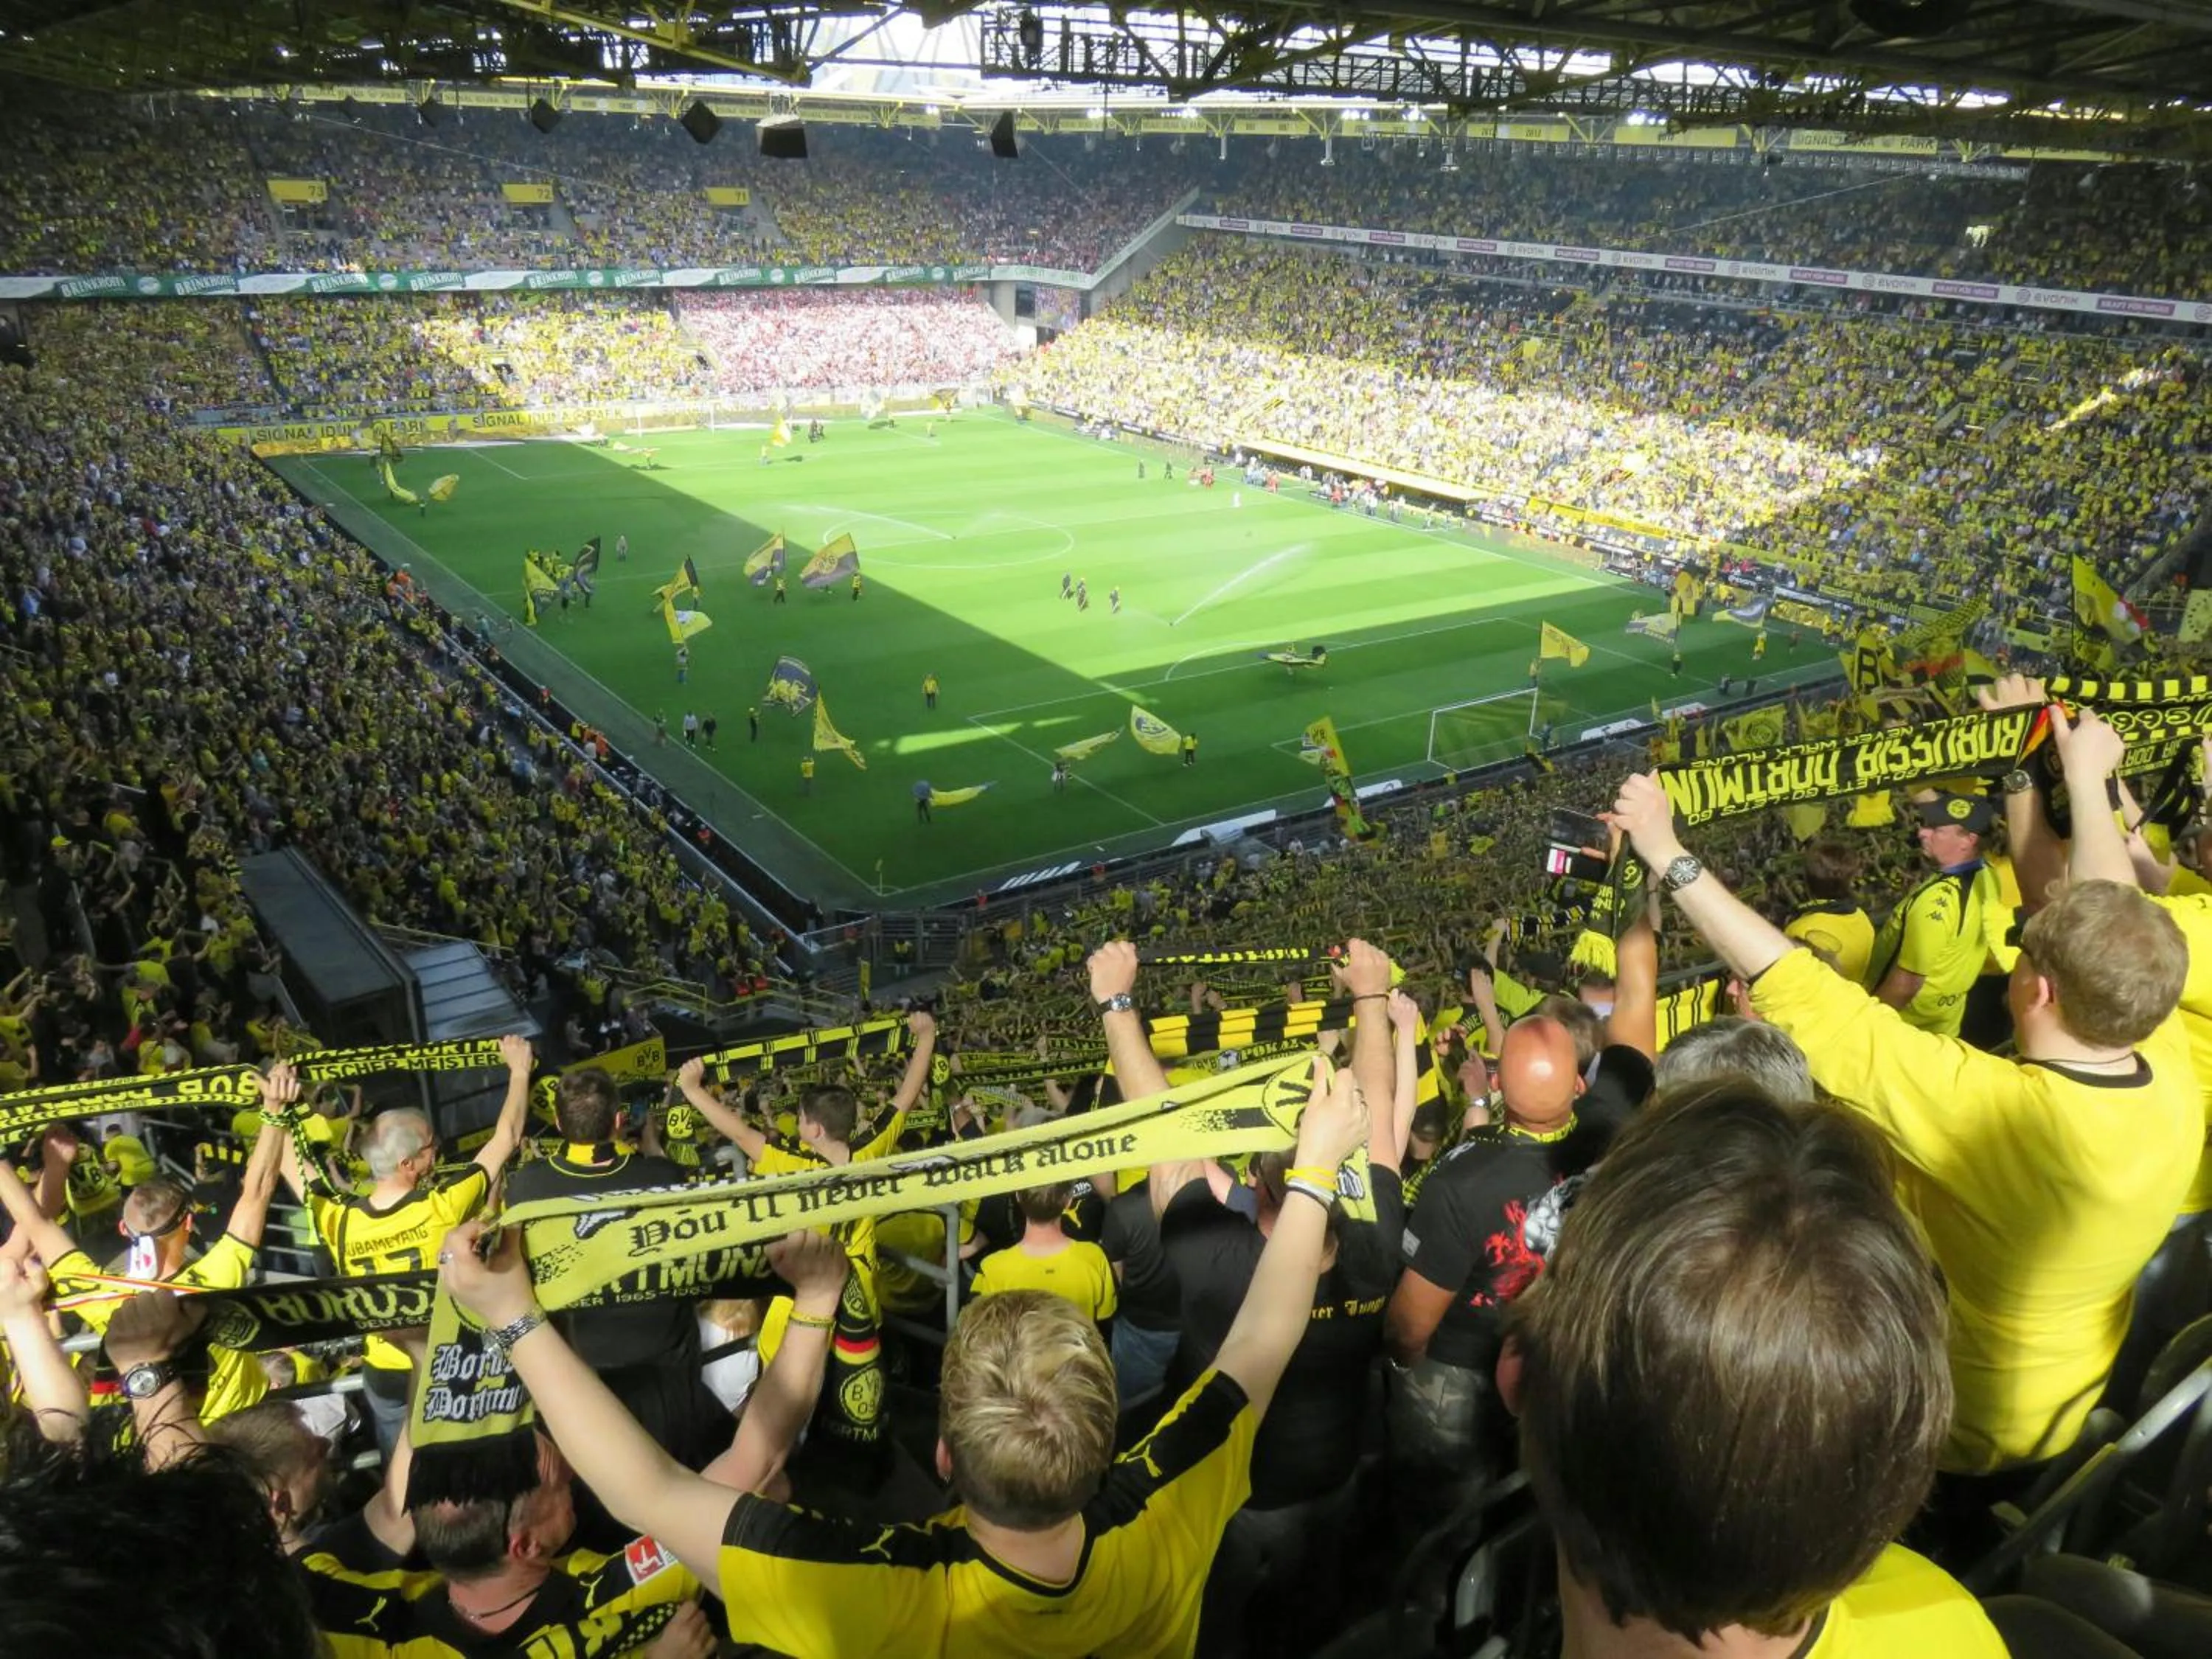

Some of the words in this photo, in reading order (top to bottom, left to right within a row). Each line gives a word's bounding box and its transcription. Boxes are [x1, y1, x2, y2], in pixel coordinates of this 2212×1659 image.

[310, 184, 324, 198] 73
[536, 188, 550, 200] 72
[735, 192, 746, 203] 71
[473, 412, 524, 428] SIGNAL
[1844, 726, 1914, 747] NEVER
[1775, 740, 1837, 759] WALK
[1690, 750, 1767, 768] ALONE
[1659, 749, 1841, 817] DORTMUN
[1687, 807, 1713, 827] GO
[406, 1053, 501, 1070] MEISTER
[636, 1046, 661, 1067] BVB
[797, 1175, 902, 1215] never
[921, 1147, 1026, 1186] walk
[1036, 1133, 1138, 1168] alone
